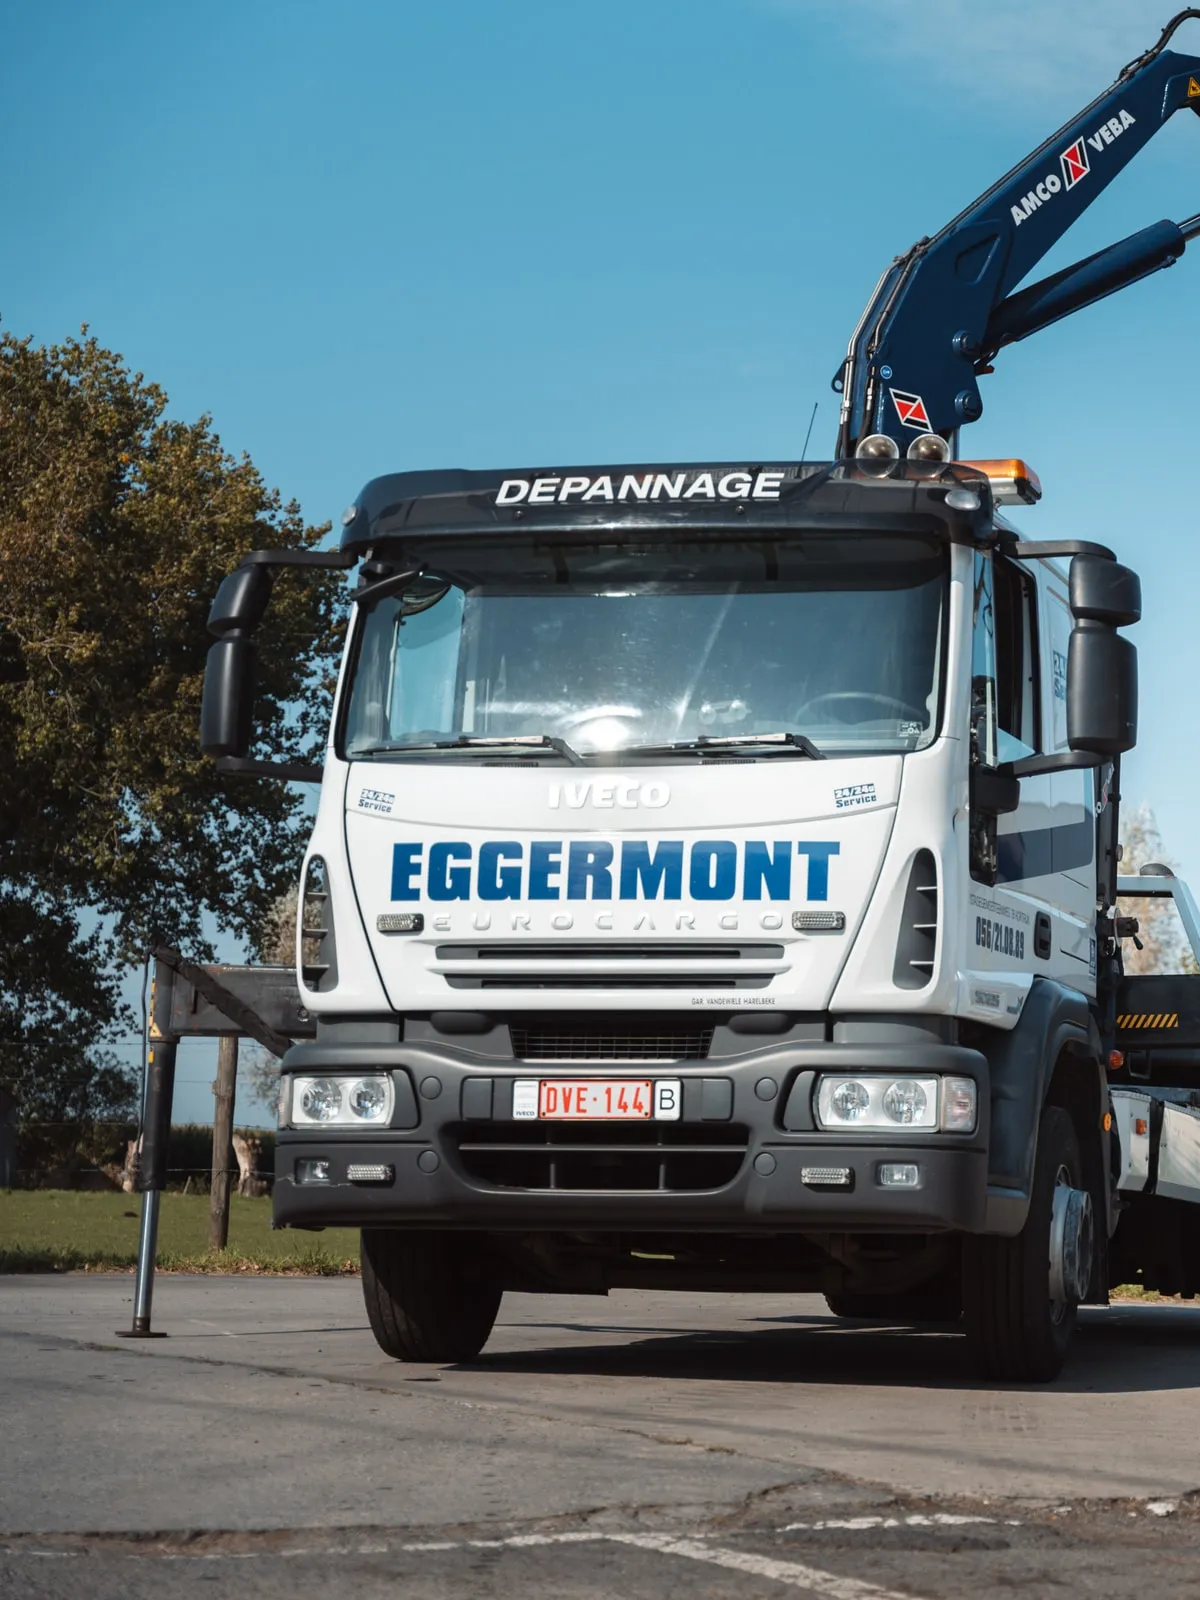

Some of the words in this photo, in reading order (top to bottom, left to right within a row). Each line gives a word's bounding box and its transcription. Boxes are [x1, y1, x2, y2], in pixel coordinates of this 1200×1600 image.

[1010, 174, 1061, 226] AMCO
[1087, 109, 1136, 152] VEBA
[495, 472, 786, 504] DEPANNAGE
[549, 779, 671, 809] IVECO
[836, 795, 877, 808] Service
[358, 799, 392, 813] Service
[391, 841, 841, 901] EGGERMONT
[432, 912, 784, 932] EUROCARGO
[743, 997, 776, 1005] HARELBEKE
[660, 1089, 675, 1110] B
